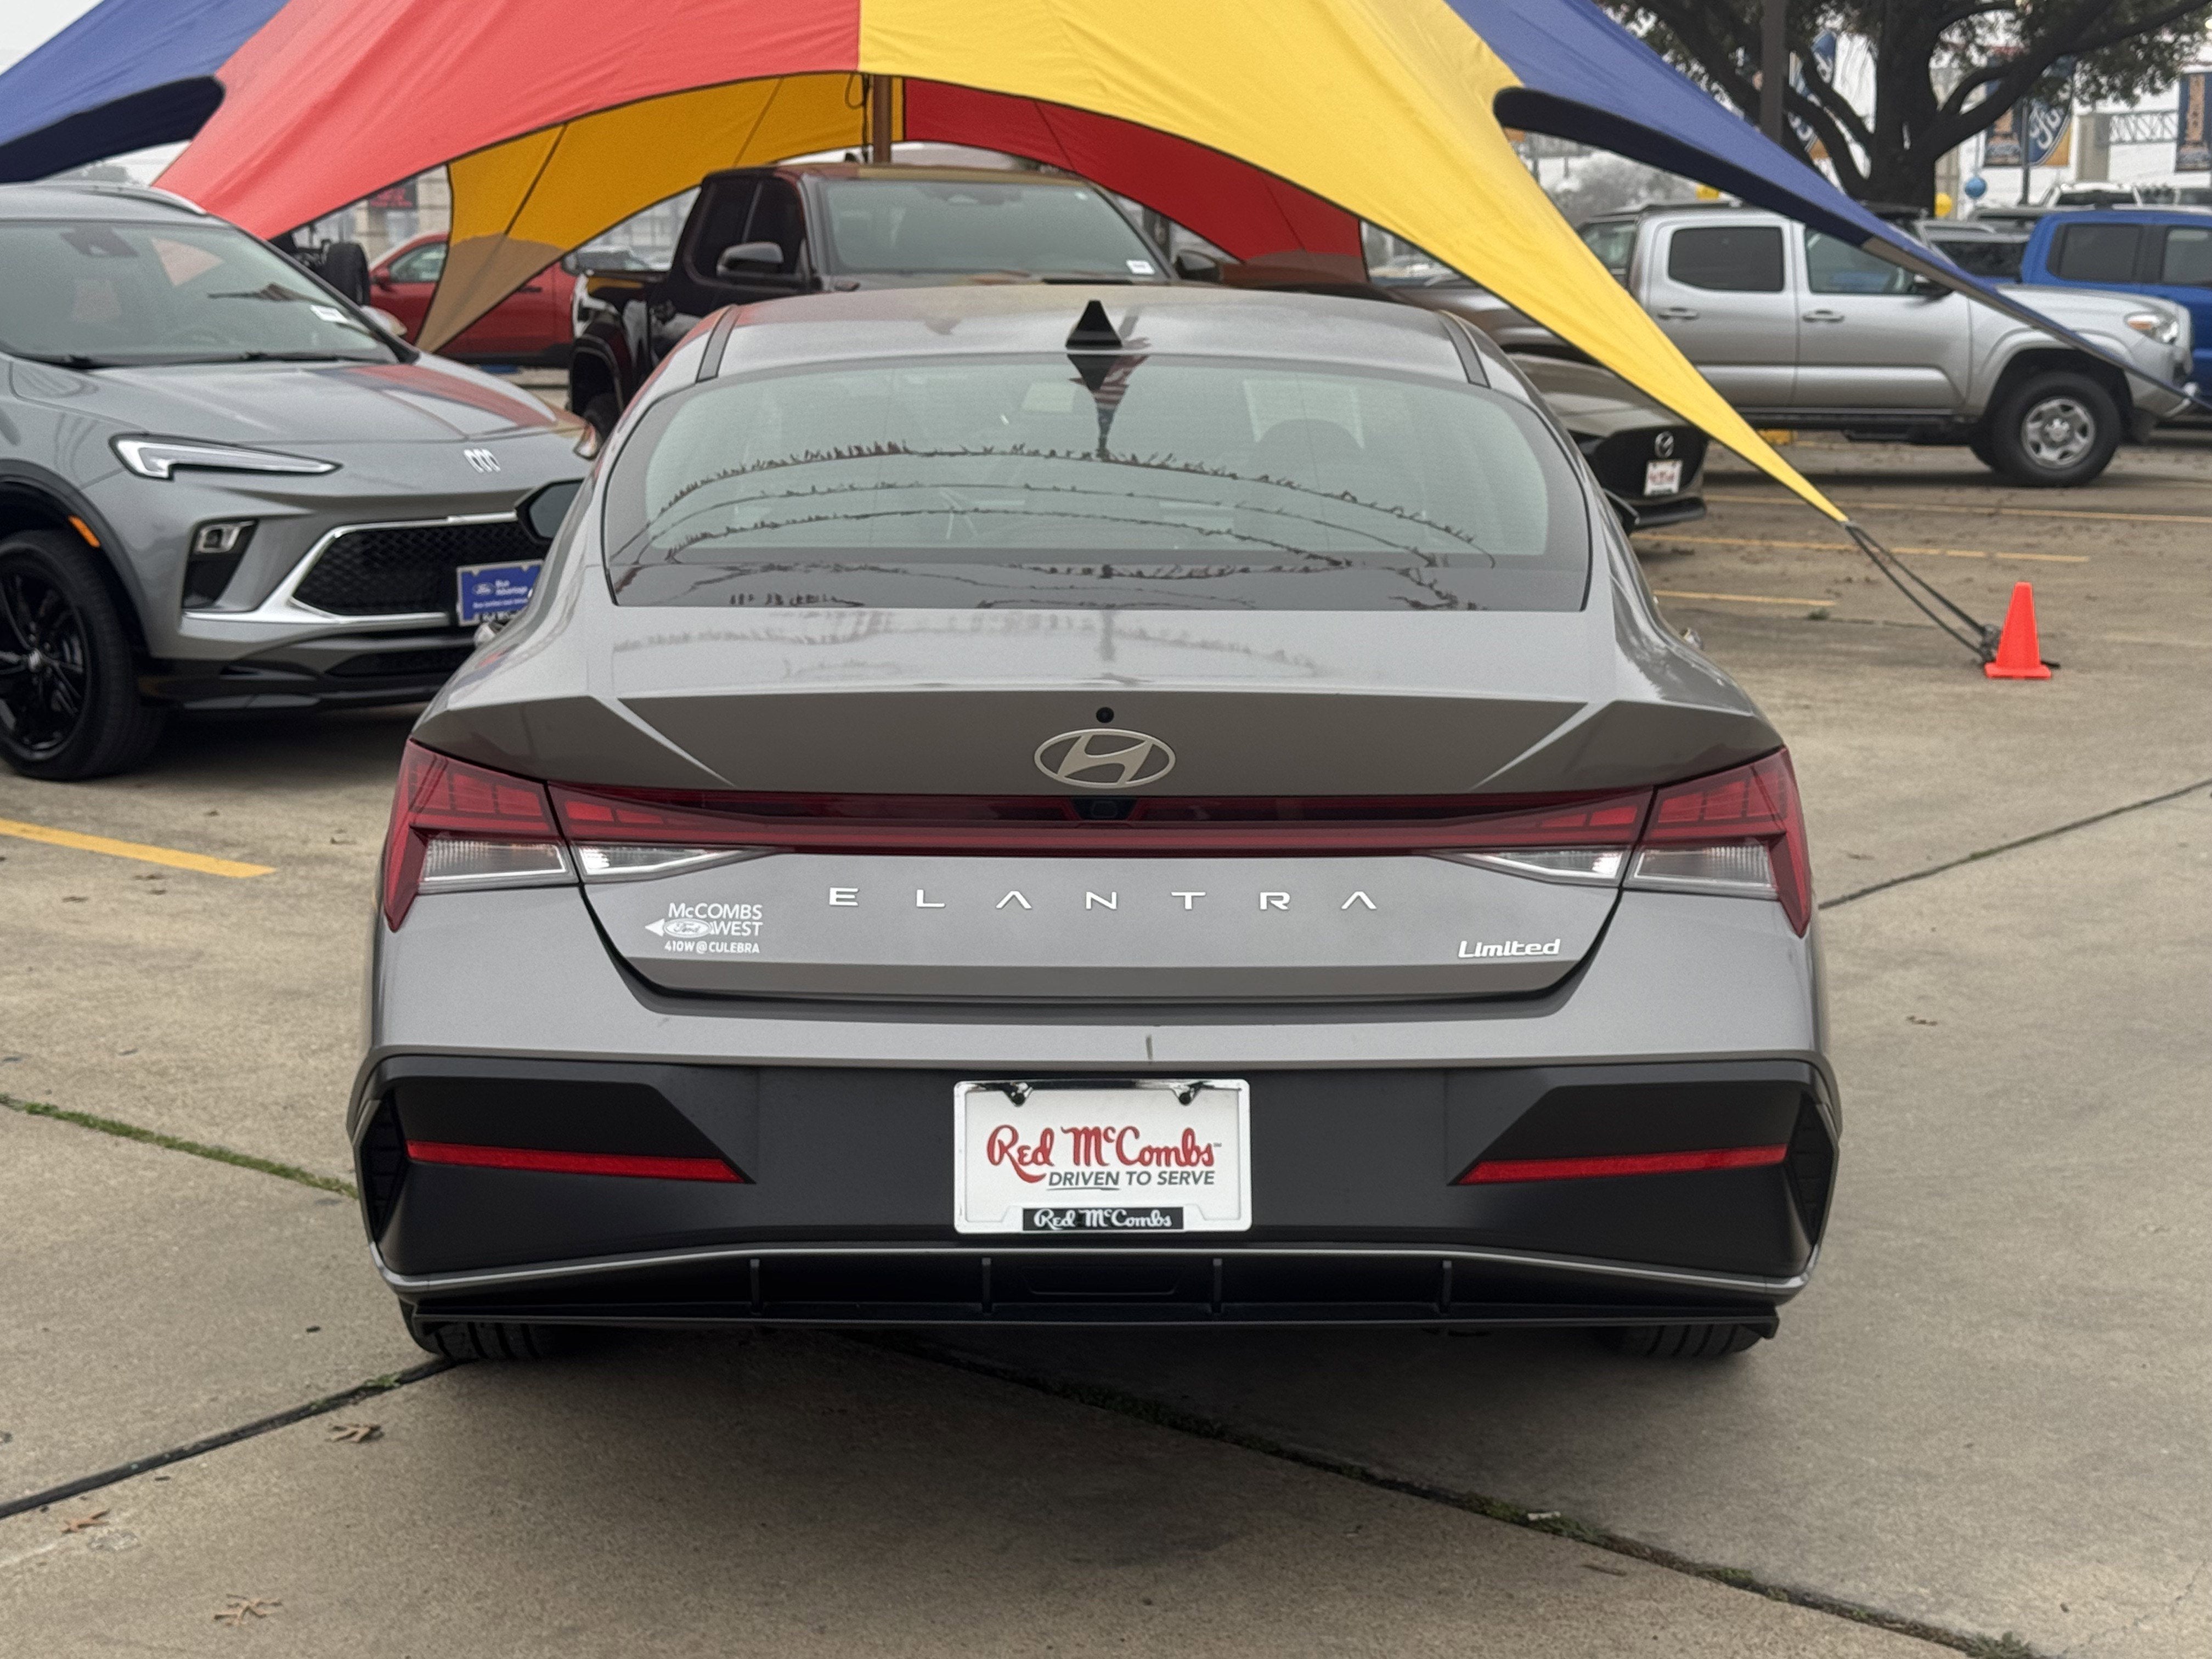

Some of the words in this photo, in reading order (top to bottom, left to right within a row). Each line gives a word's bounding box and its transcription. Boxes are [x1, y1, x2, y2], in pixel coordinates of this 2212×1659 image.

[829, 887, 1377, 910] ELANTRA
[668, 902, 763, 920] McCOMBS
[713, 921, 763, 936] WEST
[1458, 938, 1561, 958] Limited
[987, 1124, 1054, 1183] Red
[1049, 1171, 1120, 1186] DRIVEN
[1126, 1171, 1152, 1186] TO
[1157, 1170, 1215, 1186] SERVE
[1034, 1209, 1076, 1231] Red
[1078, 1209, 1172, 1227] McCombs
